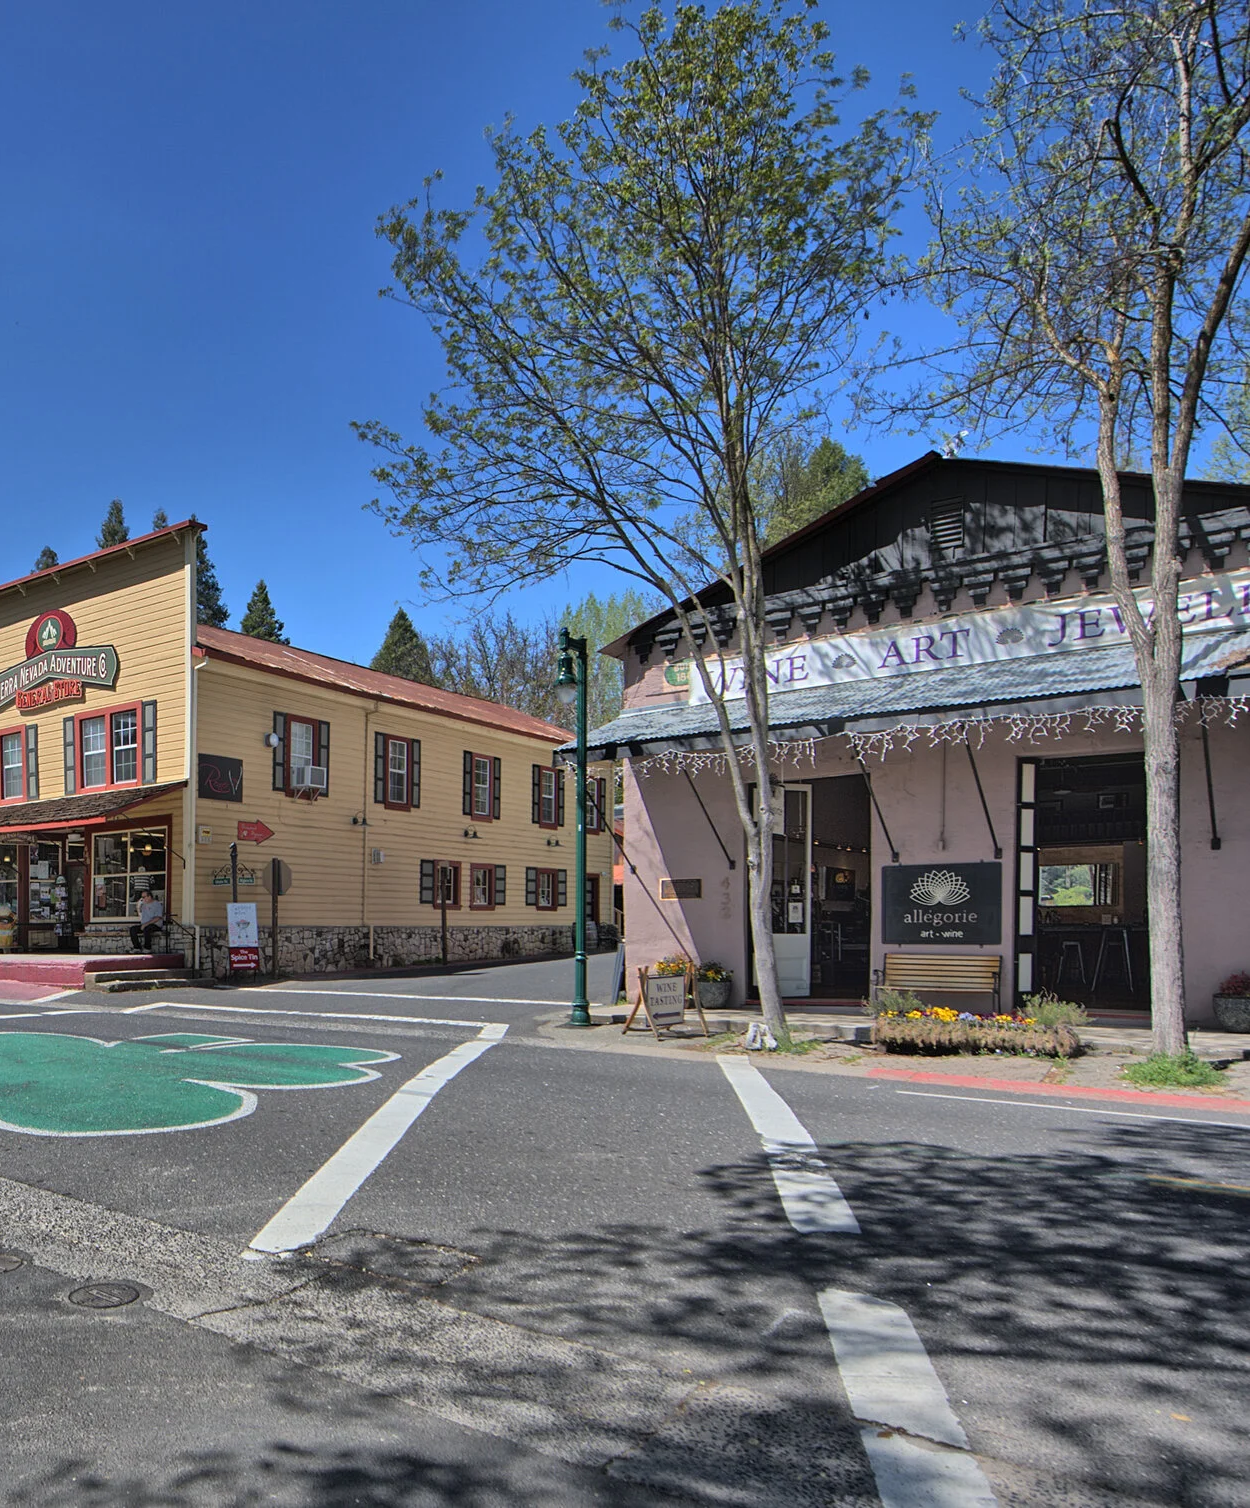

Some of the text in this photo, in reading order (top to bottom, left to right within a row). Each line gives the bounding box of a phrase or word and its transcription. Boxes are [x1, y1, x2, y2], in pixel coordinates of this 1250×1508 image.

[696, 655, 810, 692] WNE
[877, 629, 971, 669] ART
[19, 659, 49, 688] NEVADA
[50, 654, 97, 677] ADVENTURE
[16, 680, 81, 709] GENERAL STORE
[920, 929, 964, 938] art wine
[230, 953, 248, 962] Spice
[656, 982, 678, 992] WINE
[650, 994, 683, 1006] TASTING
